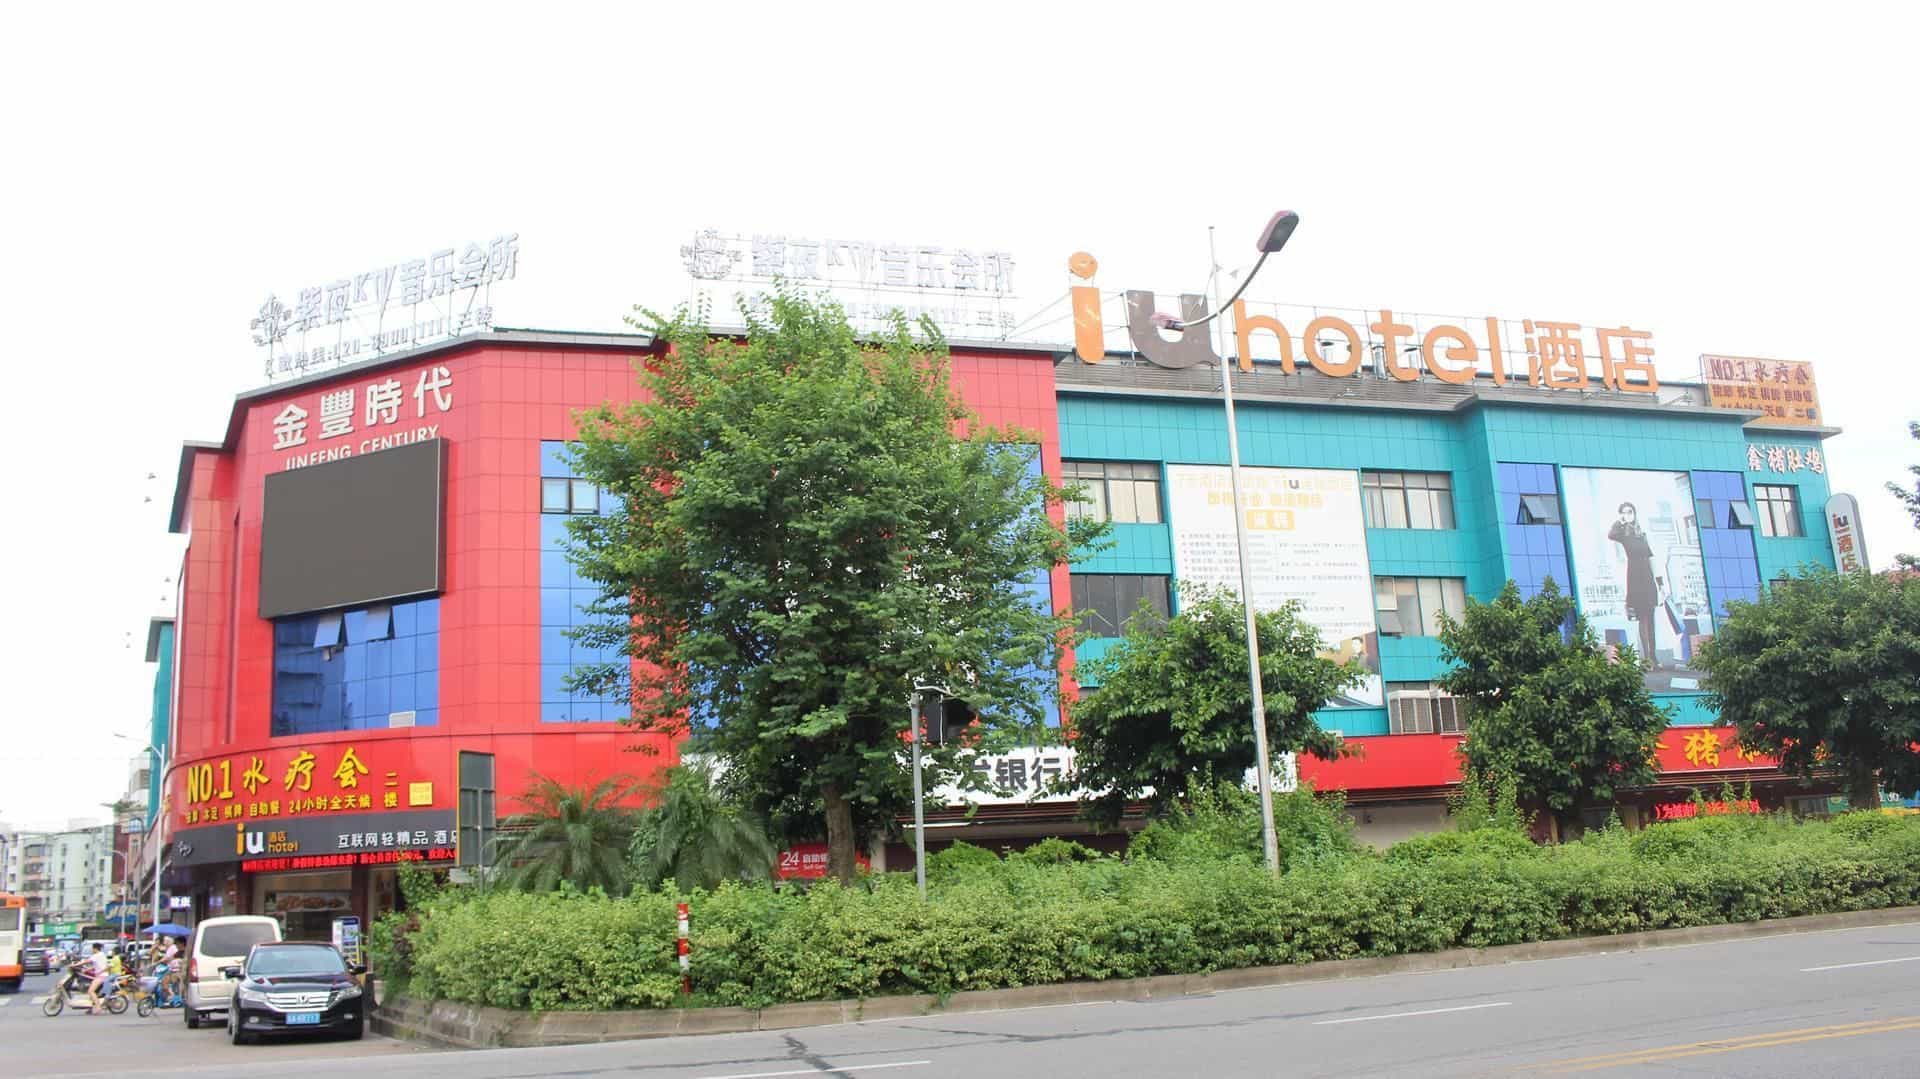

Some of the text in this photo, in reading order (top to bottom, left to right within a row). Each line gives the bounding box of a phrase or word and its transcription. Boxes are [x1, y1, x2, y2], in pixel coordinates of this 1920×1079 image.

[1233, 298, 1507, 389] hotel
[1523, 318, 1660, 394] 酒店
[273, 366, 454, 451] 金豐時代
[360, 424, 439, 456] CENTURY
[236, 823, 265, 855] iu
[268, 841, 299, 853] hotel
[781, 851, 800, 867] 24
